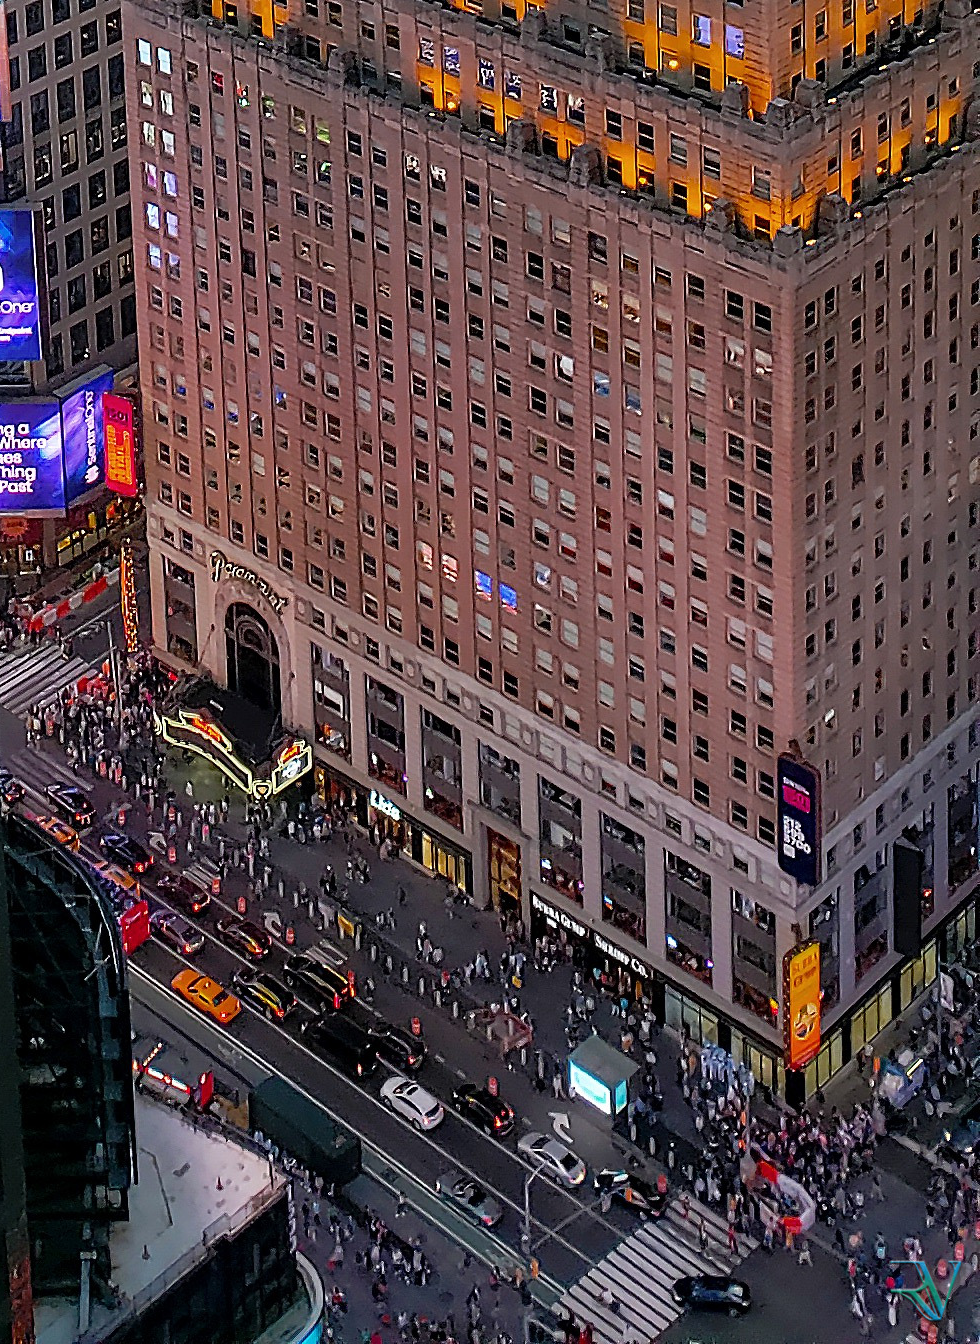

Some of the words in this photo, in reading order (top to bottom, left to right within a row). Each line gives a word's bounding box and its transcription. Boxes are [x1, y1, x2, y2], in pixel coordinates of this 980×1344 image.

[18, 423, 30, 434] a
[0, 479, 33, 493] Past
[210, 550, 288, 613] Paramount
